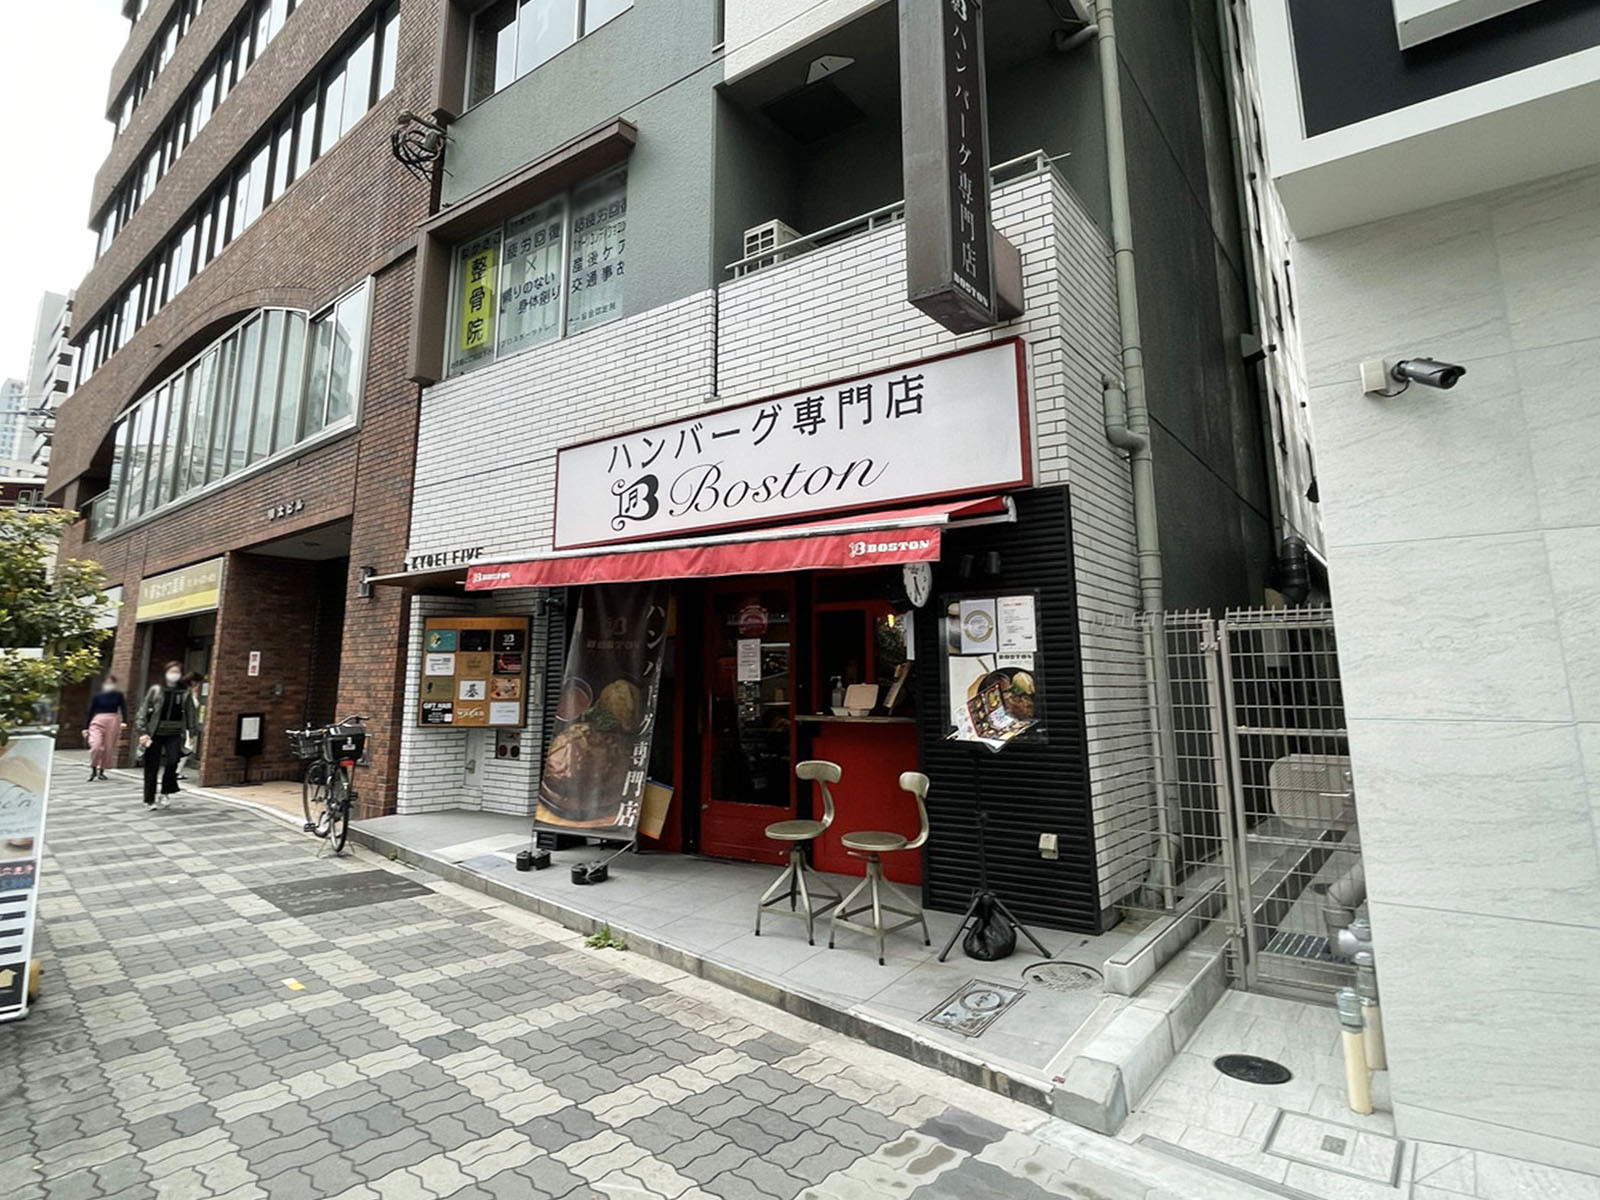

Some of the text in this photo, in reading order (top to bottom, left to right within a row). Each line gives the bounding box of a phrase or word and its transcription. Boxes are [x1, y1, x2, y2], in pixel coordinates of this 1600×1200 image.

[952, 25, 978, 278] ハンバーグ専門店
[467, 255, 487, 345] 整骨院
[608, 373, 925, 473] ハンバーグ専門店
[669, 457, 889, 517] Boston
[867, 540, 930, 553] BOSTON
